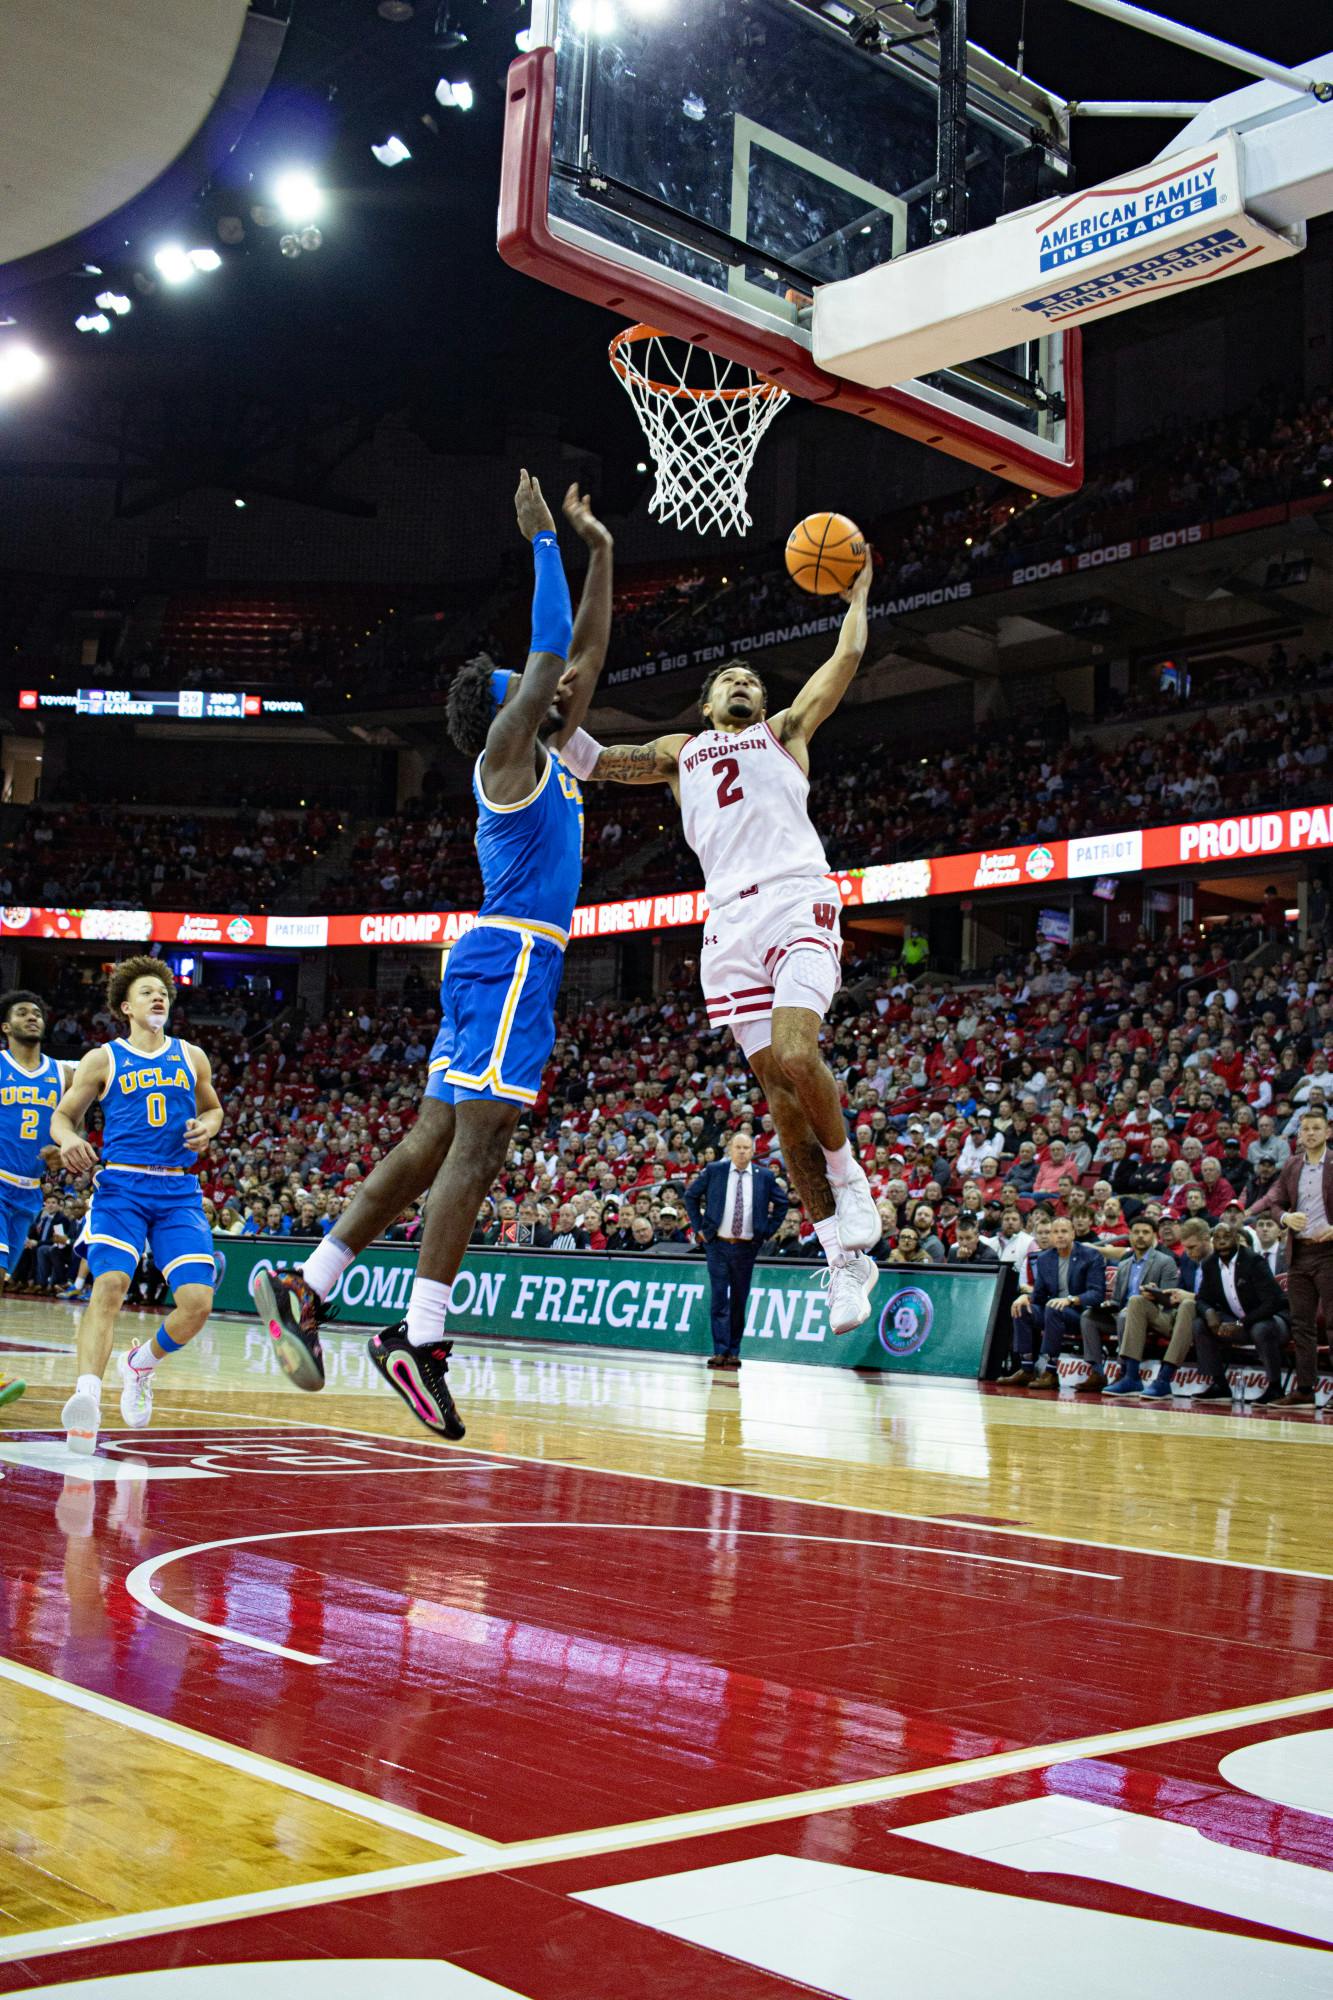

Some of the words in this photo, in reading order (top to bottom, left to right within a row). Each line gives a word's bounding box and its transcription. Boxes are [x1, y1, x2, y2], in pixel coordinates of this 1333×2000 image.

[1040, 200, 1137, 252] AMERICAN
[1145, 168, 1216, 212] FAMILY
[1052, 199, 1203, 264] INSURANCE
[1042, 237, 1220, 306] INSURANCE
[1126, 238, 1248, 289] AMERICAN
[1041, 279, 1123, 318] FAMILY
[1012, 560, 1063, 585] 2004
[1078, 543, 1132, 569] 2008
[1150, 526, 1201, 551] 2015
[608, 662, 656, 686] MEN'S
[661, 653, 689, 673] BIG
[695, 643, 726, 664] TEN
[730, 613, 848, 656] TOURNAMEN
[40, 694, 79, 706] TOYOTA
[105, 690, 130, 702] TCU
[262, 700, 304, 713] TOYOTA
[684, 738, 768, 773] WISCONSIN
[712, 758, 744, 809] 2
[1077, 841, 1134, 863] PATRIOT
[1180, 815, 1283, 861] PROUD
[275, 924, 320, 936] PATRIOT
[360, 915, 440, 943] CHOMP
[598, 899, 653, 933] BREW
[654, 894, 694, 926] PUB
[0, 1086, 58, 1109] UCLA
[118, 1067, 191, 1096] UCLA
[19, 1108, 40, 1140] 2
[146, 1092, 167, 1128] 0
[511, 1274, 704, 1332] FREIGHT
[741, 1287, 831, 1342] INE
